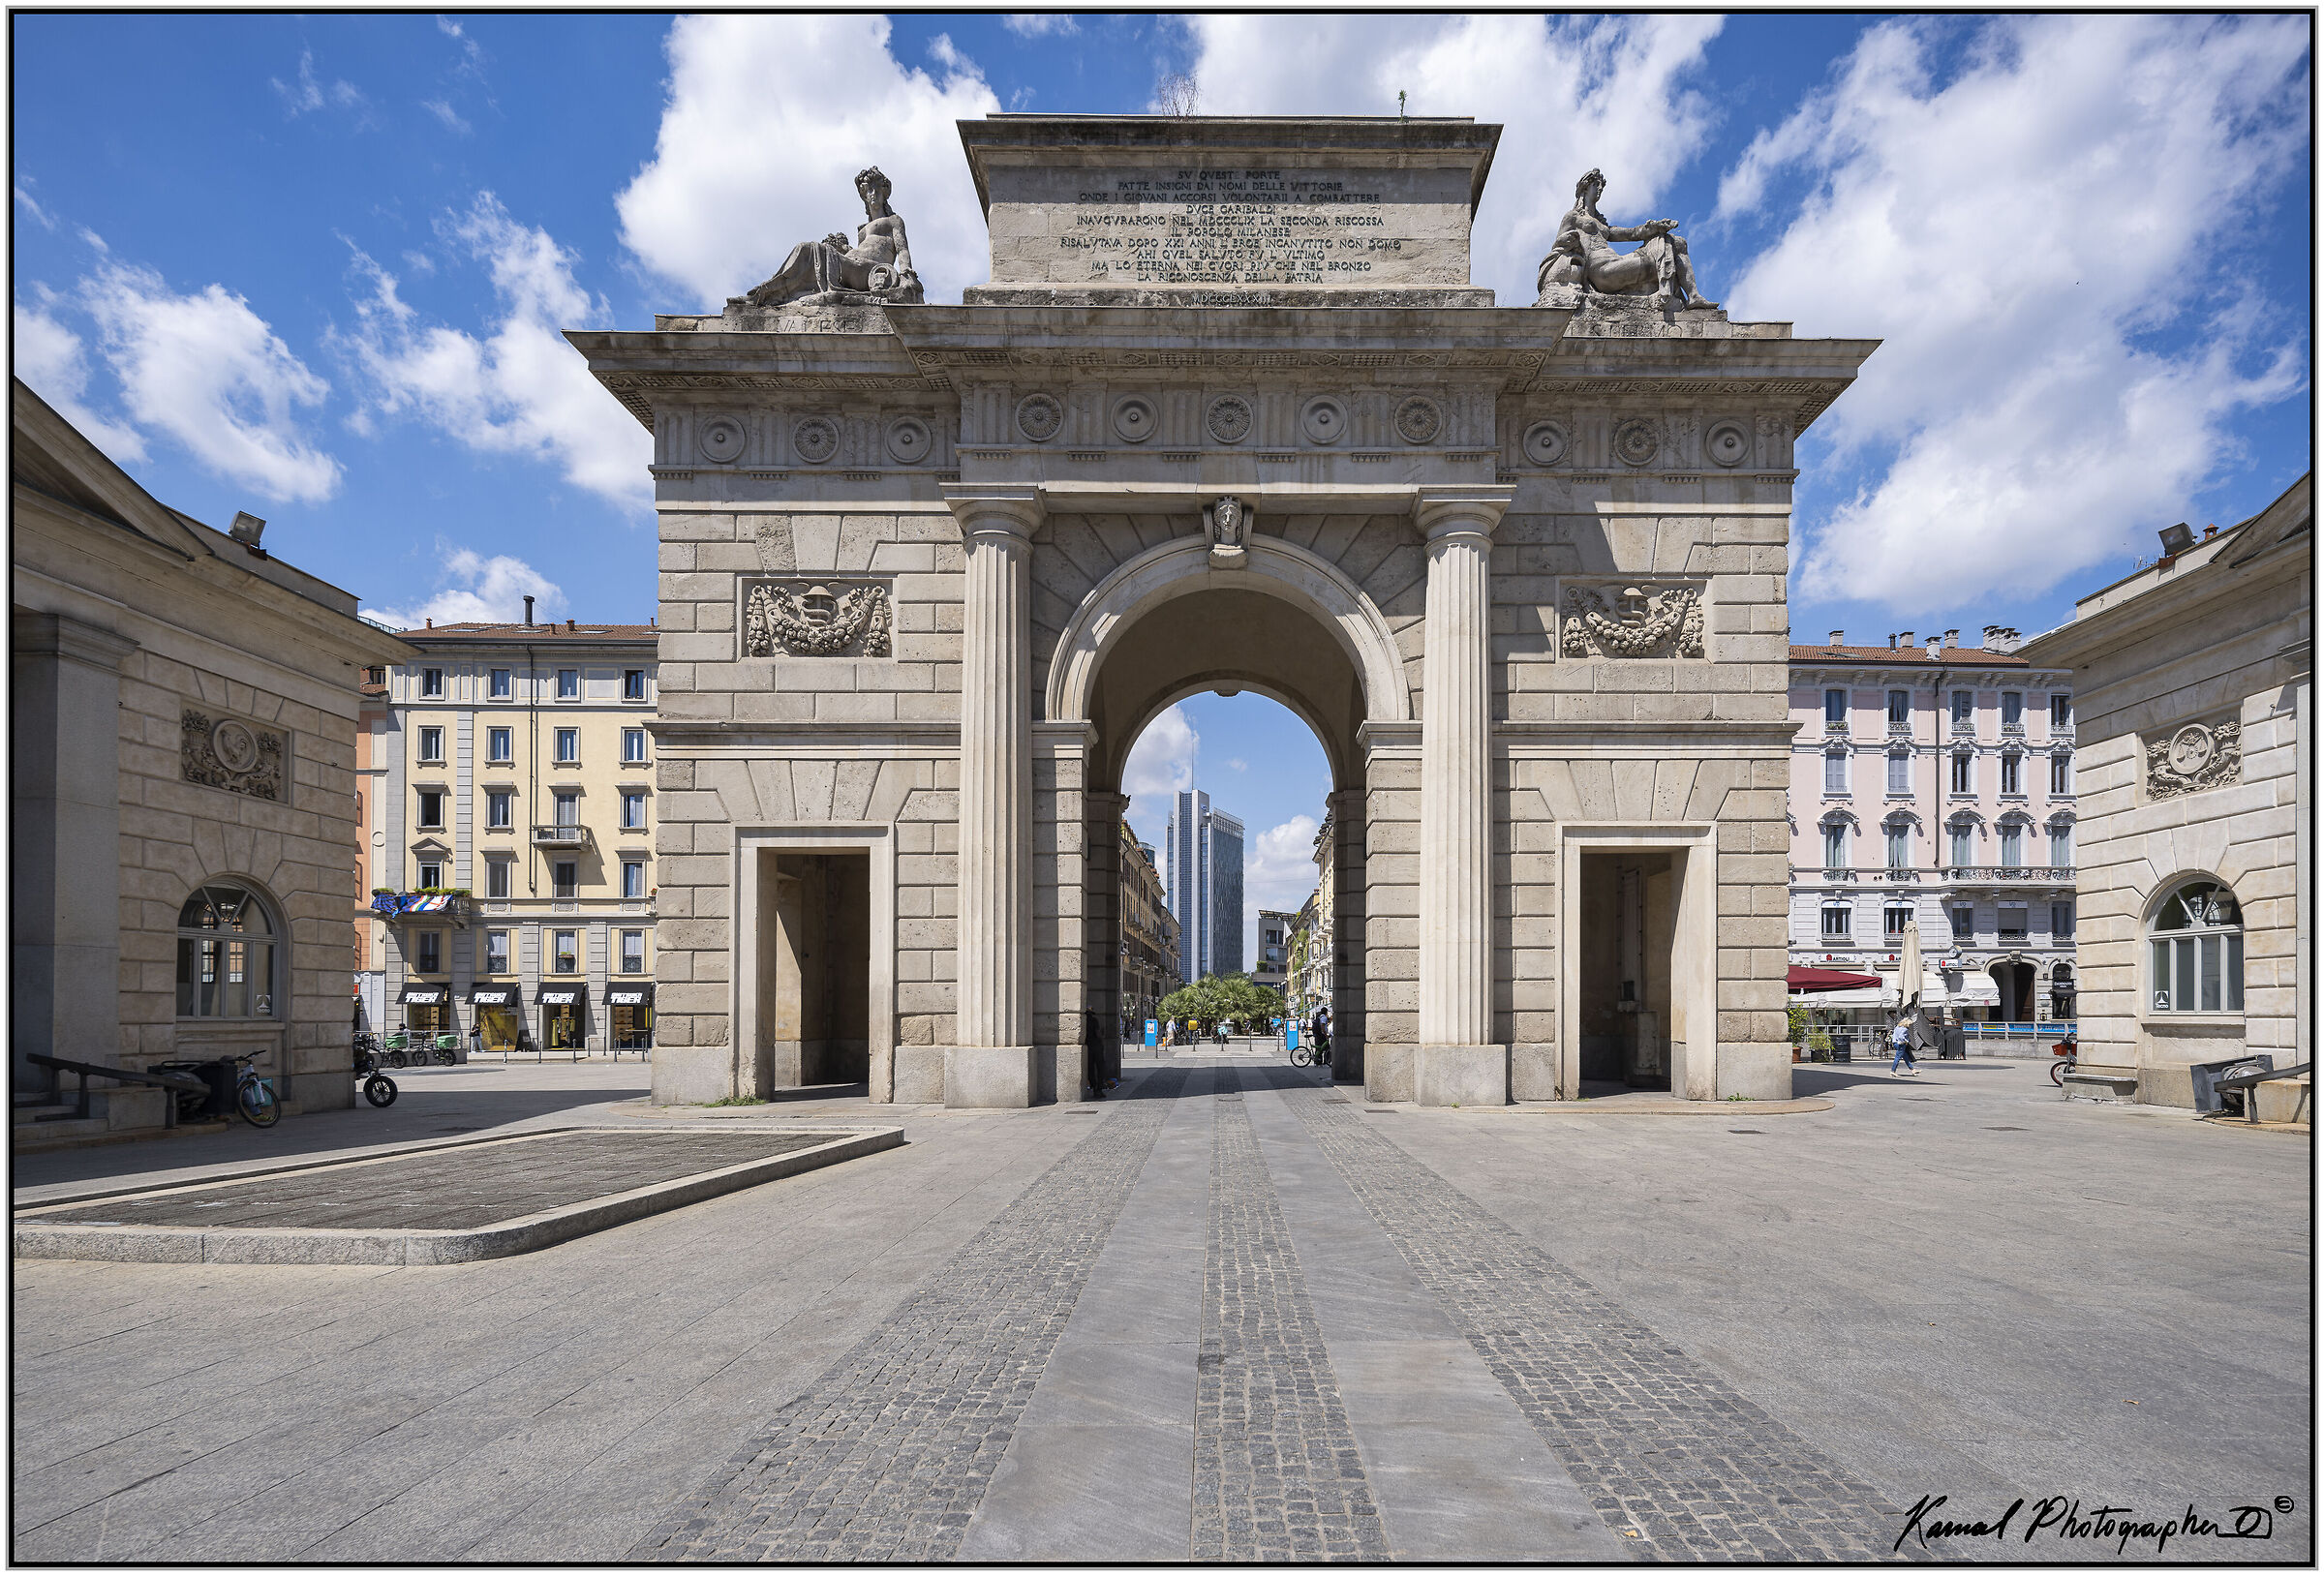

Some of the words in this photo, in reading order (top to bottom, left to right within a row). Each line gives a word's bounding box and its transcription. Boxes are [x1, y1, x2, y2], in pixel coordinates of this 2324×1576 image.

[1178, 171, 1192, 179] SV
[1246, 171, 1280, 179] PORTE
[1118, 182, 1149, 190] FATTE
[1156, 182, 1192, 191] INSIGNI
[1197, 182, 1214, 191] DAI
[1219, 182, 1246, 191] NOMI
[1252, 183, 1285, 191] DELLE
[1290, 183, 1343, 191] VITTORIE
[1186, 205, 1213, 215] DVCE
[1220, 205, 1276, 215] GARIBALDI
[1077, 215, 1166, 225] INAVGVRARONO
[1172, 216, 1193, 225] NEL
[1198, 216, 1255, 226] MDCCCLIX
[1260, 216, 1275, 226] LA
[1280, 216, 1329, 226] SECONDA
[1335, 216, 1384, 226] RISCOSSA
[1171, 228, 1182, 237] IL
[1188, 228, 1232, 237] POPOLO
[1237, 228, 1290, 238] MILANESE
[1060, 238, 1123, 248] RISALVTAVA
[1128, 238, 1159, 248] DOPO
[1165, 238, 1184, 249] XXI
[1190, 239, 1215, 249] ANNI
[1265, 239, 1333, 249] INCANVTITO
[1339, 239, 1363, 249] NON
[1368, 239, 1401, 249] DOMO
[1137, 250, 1156, 260] AHI
[1162, 250, 1193, 260] QVEL
[1198, 250, 1243, 260] SALVTO
[1249, 250, 1264, 260] FV
[1284, 251, 1325, 260] VLTIMO
[1091, 261, 1108, 271] MA
[1116, 261, 1131, 271] LO
[1137, 261, 1180, 271] ETERNA
[1186, 261, 1202, 271] NEI
[1209, 261, 1243, 271] CVORI
[1274, 261, 1296, 271] CHE
[1301, 262, 1323, 272] NEL
[1328, 262, 1371, 272] BRONZO
[1137, 273, 1151, 282] LA
[1158, 273, 1238, 283] RICONOSCENZA
[1245, 273, 1279, 283] DELLA
[1284, 273, 1322, 283] PATRIA
